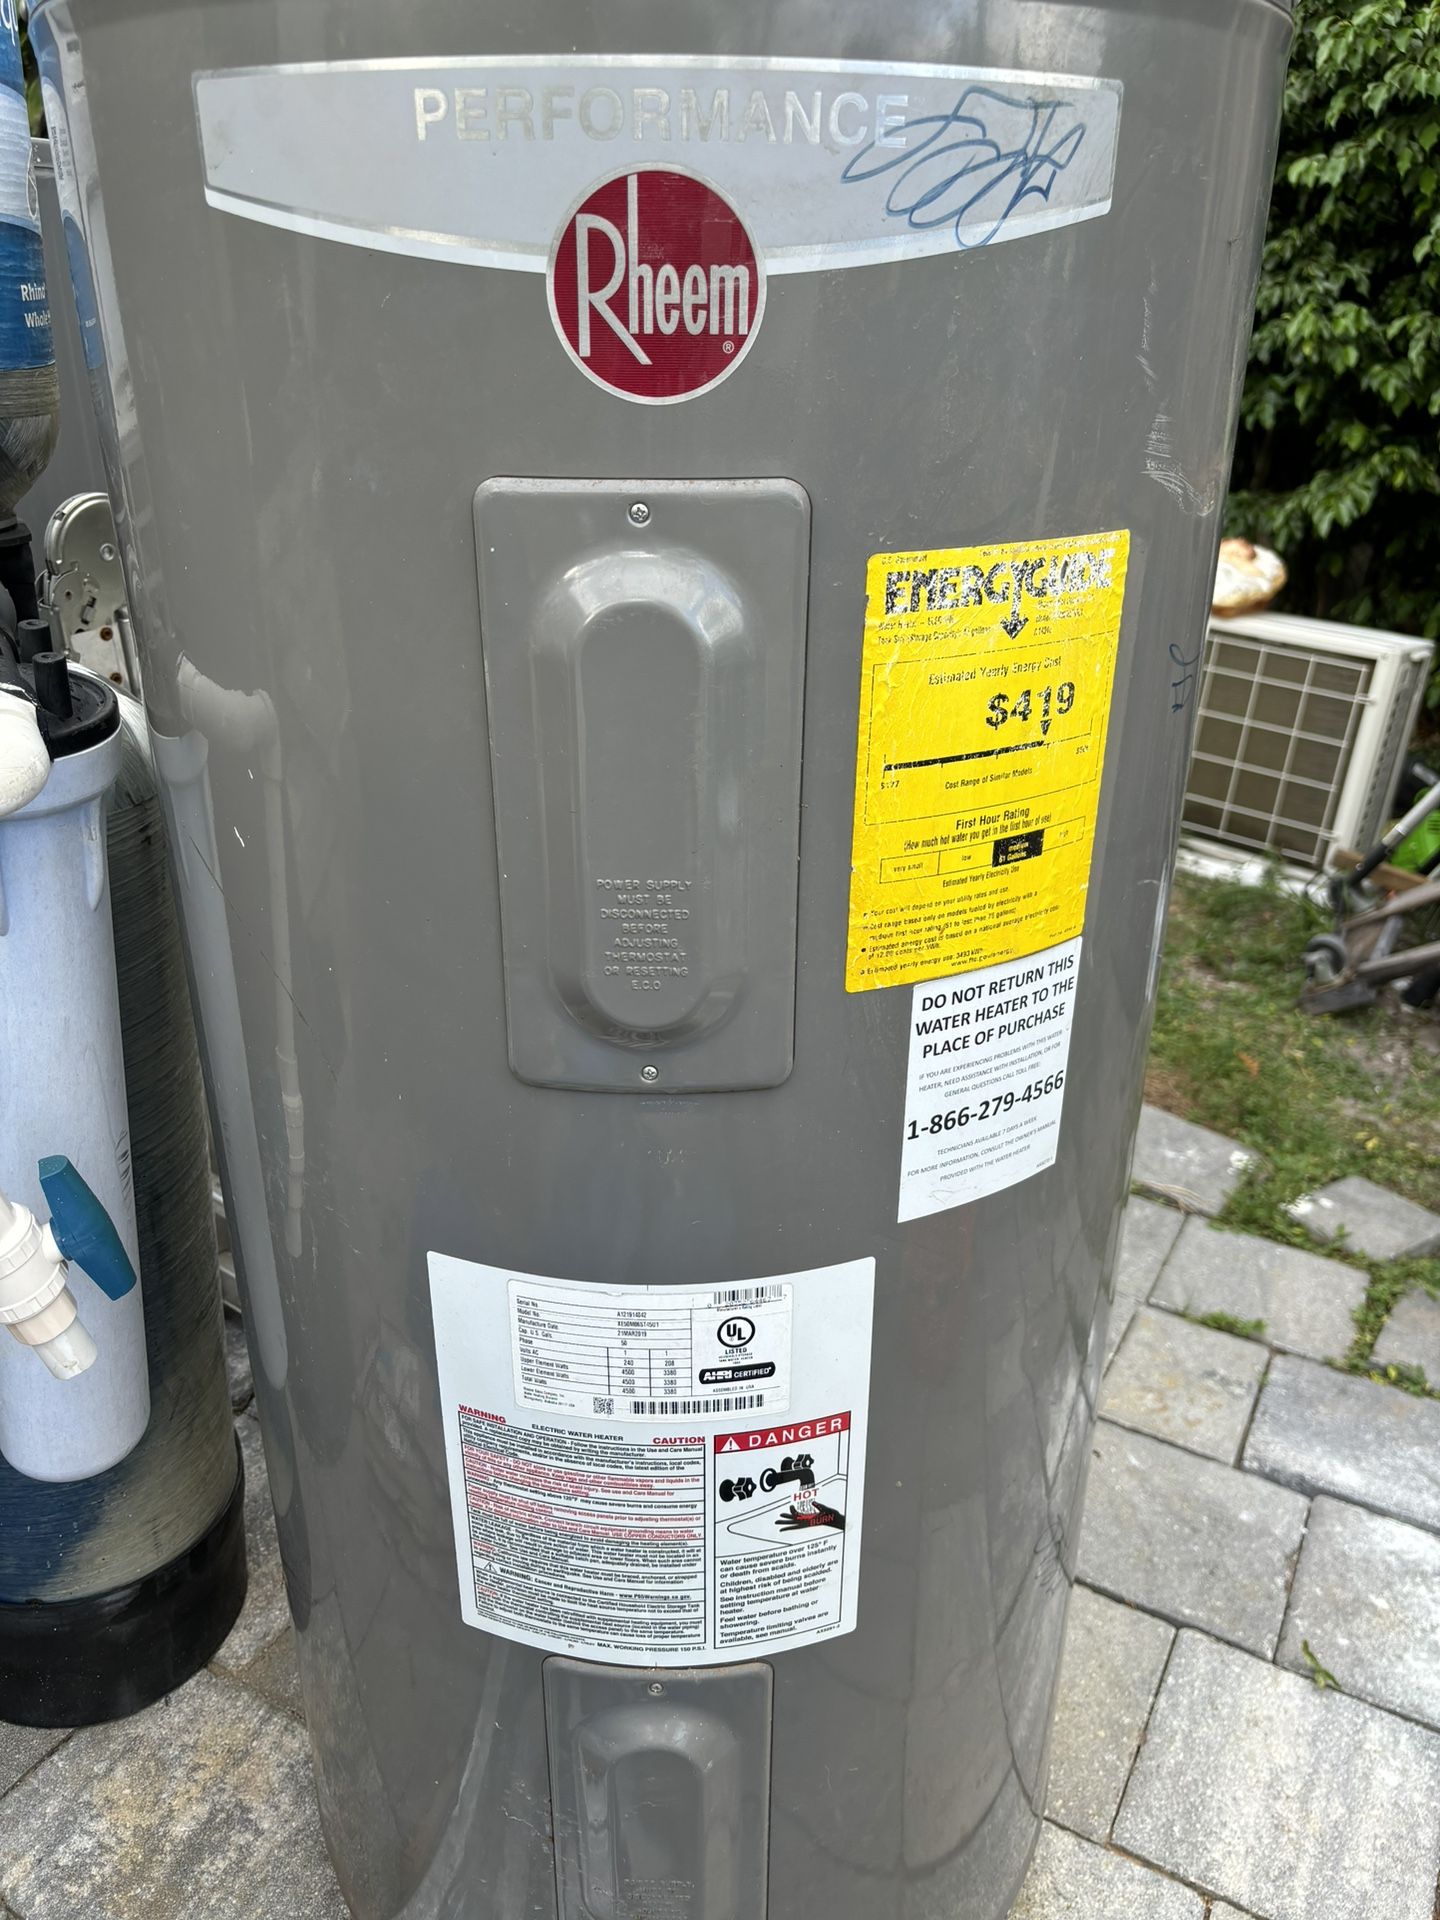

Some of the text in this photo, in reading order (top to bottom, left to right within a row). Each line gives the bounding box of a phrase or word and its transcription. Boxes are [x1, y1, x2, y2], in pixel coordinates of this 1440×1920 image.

[413, 86, 908, 148] PERFORMANCE
[575, 174, 750, 365] Rheem
[929, 656, 1061, 685] Estimated Yearly Energy Cost
[986, 682, 1075, 730] $419
[945, 768, 1033, 789] Cost Range of Similar Models
[956, 807, 1030, 830] First Hour Rating
[921, 836, 938, 848] much
[940, 834, 950, 845] hot
[951, 831, 968, 843] water
[970, 829, 980, 841] you
[982, 826, 991, 839] get
[992, 824, 998, 834] in
[999, 822, 1009, 833] the
[1010, 819, 1021, 831] first
[1022, 818, 1034, 829] hour
[1035, 815, 1040, 826] of
[596, 879, 692, 890] POWER SUPPLY
[942, 875, 968, 888] Estimated
[970, 871, 985, 883] Yearly
[985, 866, 1010, 880] Electricity
[617, 894, 672, 905] MUST BE
[600, 908, 690, 920] DISCONNECTED
[622, 923, 668, 934] BEFORE
[614, 937, 678, 948] ADJUSTING
[604, 952, 687, 962] THERMOSTAT
[603, 966, 689, 977] OR RESETTING
[922, 955, 1074, 1011] DO NOT RETURN THIS
[916, 976, 1075, 1036] WATER HEATER TO THE
[923, 1002, 1065, 1058] PLACE OF PURCHASE
[926, 1071, 940, 1079] YOU
[940, 1067, 952, 1076] ARE
[953, 1055, 993, 1073] EXPERIENCING
[993, 1047, 1021, 1061] PROBLEMS
[1021, 1042, 1035, 1051] WITH
[1036, 1037, 1047, 1045] THIS
[1047, 1029, 1063, 1041] WATER
[918, 1082, 943, 1092] HEATER,
[944, 1076, 960, 1086] NEED
[960, 1067, 993, 1082] ASSISTANCE
[994, 1063, 1008, 1072] WITH
[1008, 1049, 1043, 1067] INSTALLATION,
[1051, 1041, 1061, 1050] FOR
[944, 1086, 970, 1098] GENERAL
[970, 1075, 1002, 1091] QUESTIONS
[1002, 1071, 1015, 1080] CALL
[1015, 1066, 1027, 1076] TOLL
[907, 1070, 1064, 1140] 1-866-279-4566
[726, 1323, 746, 1341] UL
[725, 1347, 747, 1355] LISTED
[733, 1367, 770, 1378] CERTIFIED
[459, 1404, 506, 1423] WARNING
[532, 1424, 566, 1435] ELECTRIC
[567, 1430, 593, 1439] WATER
[653, 1436, 705, 1444] CAUTION
[749, 1418, 842, 1447] DANGER
[793, 1488, 819, 1501] HOT
[809, 1514, 834, 1526] BURN
[720, 1558, 741, 1566] Water
[743, 1549, 788, 1563] temperature
[789, 1546, 805, 1554] over
[735, 1563, 757, 1571] cause
[759, 1558, 784, 1567] severe
[785, 1552, 805, 1562] burns
[807, 1544, 837, 1556] instantly
[720, 1579, 753, 1588] Children,
[755, 1572, 786, 1583] disabled
[787, 1569, 800, 1577] and
[802, 1562, 826, 1574] elderly
[729, 1583, 756, 1594] highest
[758, 1581, 772, 1589] risk
[782, 1575, 802, 1585] being
[803, 1567, 832, 1579] scalded.
[730, 1570, 750, 1578] death
[753, 1566, 769, 1574] from
[771, 1562, 796, 1571] scalds.
[720, 1600, 745, 1609] setting
[746, 1593, 790, 1606] temperature
[800, 1585, 819, 1594] water
[735, 1589, 775, 1600] instruction
[776, 1583, 802, 1593] manual
[803, 1577, 826, 1587] before
[758, 1608, 782, 1618] before
[783, 1602, 809, 1613] bathing
[720, 1619, 759, 1630] showering.
